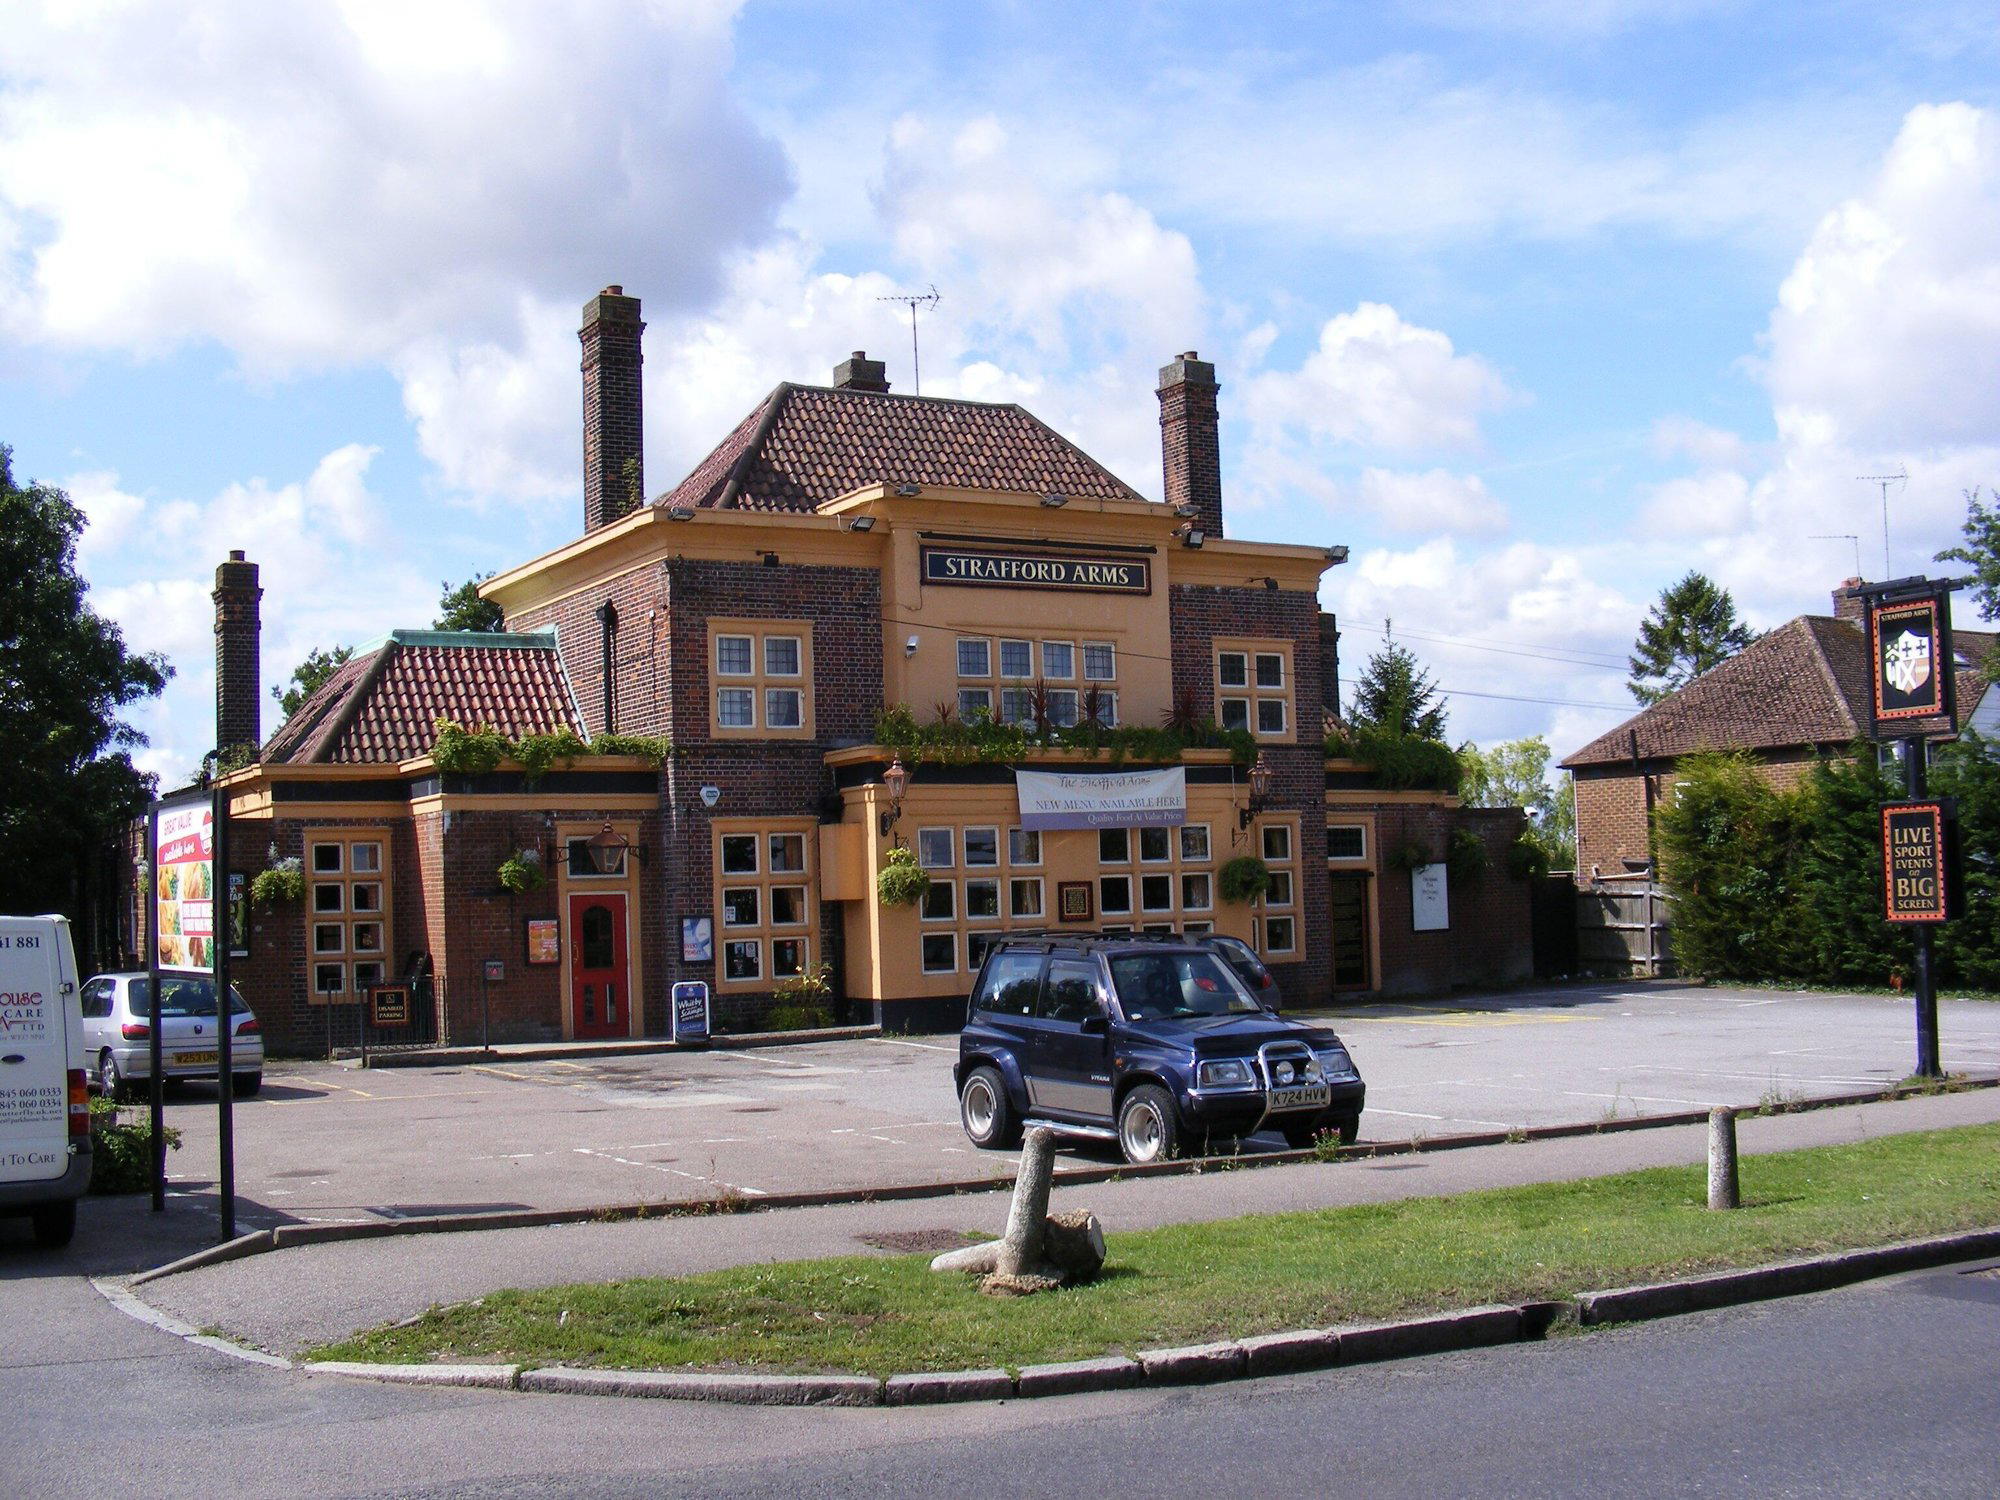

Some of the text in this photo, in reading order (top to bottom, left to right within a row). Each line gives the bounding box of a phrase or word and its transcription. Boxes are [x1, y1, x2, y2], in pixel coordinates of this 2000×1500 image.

[946, 557, 1129, 585] STRAFFORD ARMS
[1913, 608, 1930, 617] ARMS
[1060, 775, 1151, 791] The Strafford Arms
[1036, 796, 1182, 810] NEW MENU AVAILABLE HERE
[1088, 812, 1182, 825] Quality Food At Value Prices
[1894, 827, 1932, 845] LIVE
[1894, 845, 1932, 857] SPORT
[1896, 859, 1933, 869] EVENTS
[1897, 877, 1934, 897] BIG
[1898, 899, 1934, 909] SCREEN
[16, 936, 40, 949] 881
[677, 998, 703, 1009] Whitby
[4, 1009, 44, 1018] CARE
[1090, 1074, 1110, 1082] VITARA
[0, 1087, 61, 1098] 845 060 0333
[1273, 1087, 1327, 1104] K724 HVW
[0, 1100, 17, 1109] 845
[20, 1099, 37, 1108] 060
